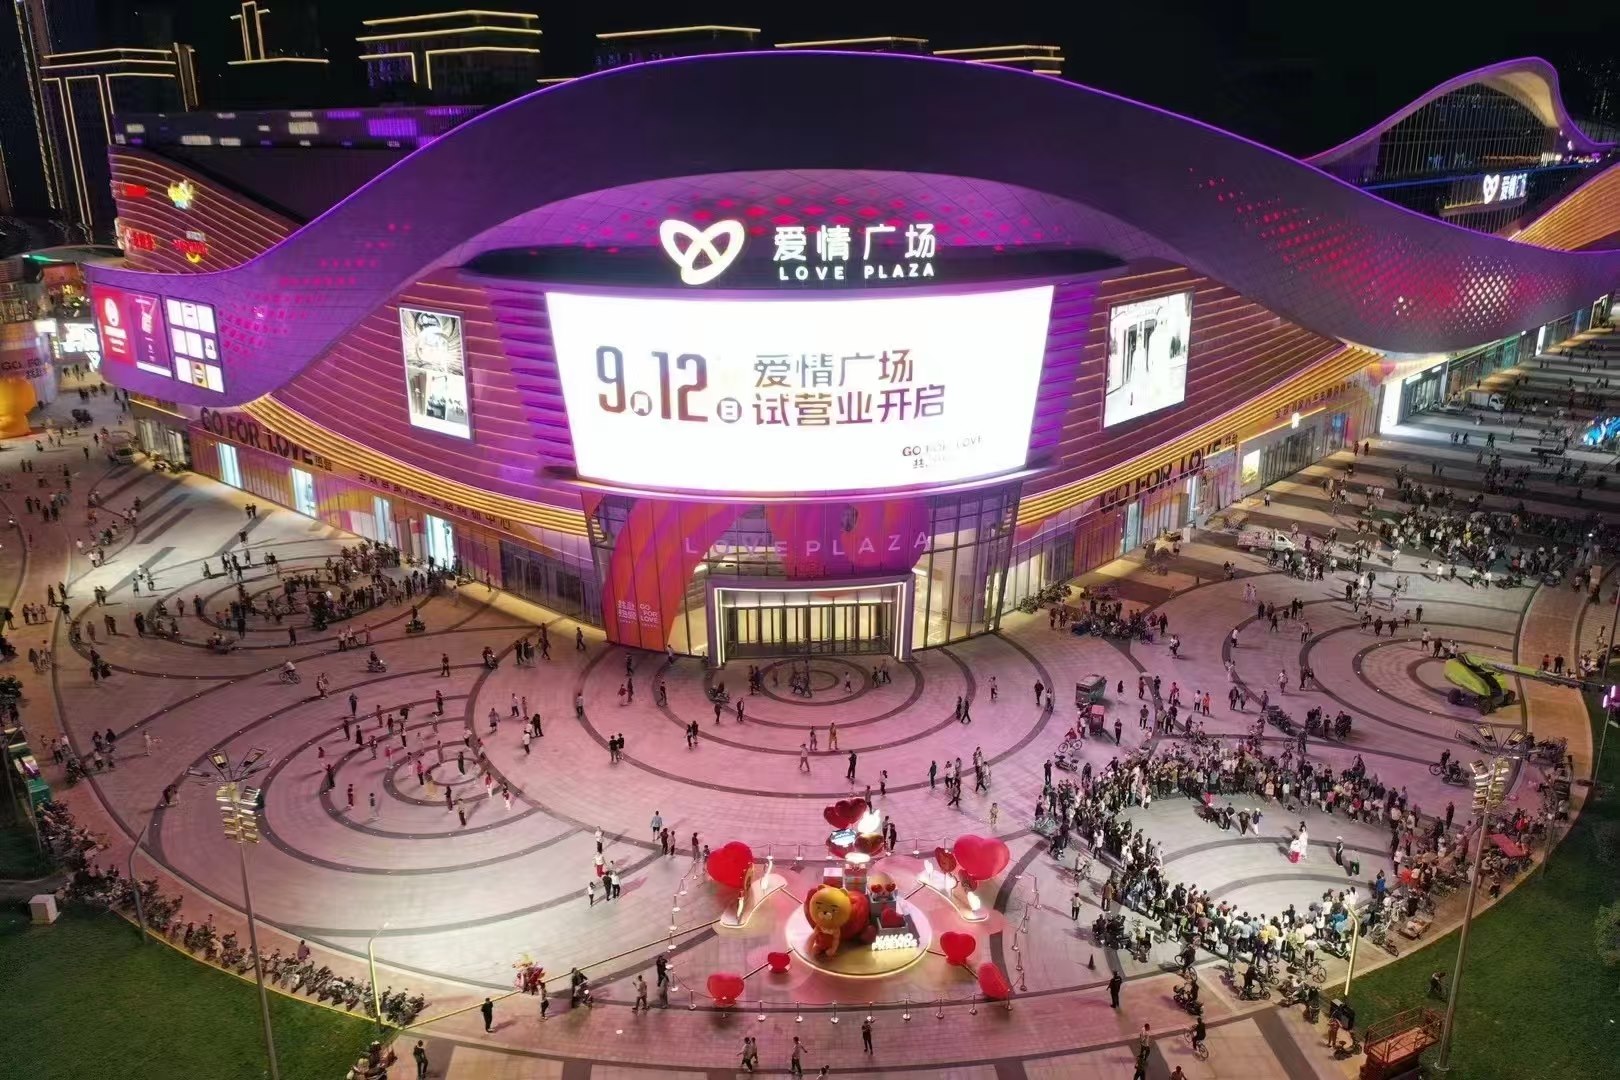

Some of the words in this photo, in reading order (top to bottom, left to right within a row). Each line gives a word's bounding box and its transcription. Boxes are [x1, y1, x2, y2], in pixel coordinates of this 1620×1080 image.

[773, 223, 936, 261] 爱情广场
[779, 266, 845, 280] LOVE
[864, 263, 934, 279] PLAZA
[753, 349, 914, 388] 爱情广场
[752, 384, 946, 427] 试营业开启
[200, 406, 224, 436] GO
[227, 415, 261, 449] FOR
[902, 446, 922, 456] GO
[1101, 482, 1130, 514] GO
[685, 537, 788, 557] LOVE
[806, 531, 930, 556] PLAZA
[640, 603, 651, 611] GO
